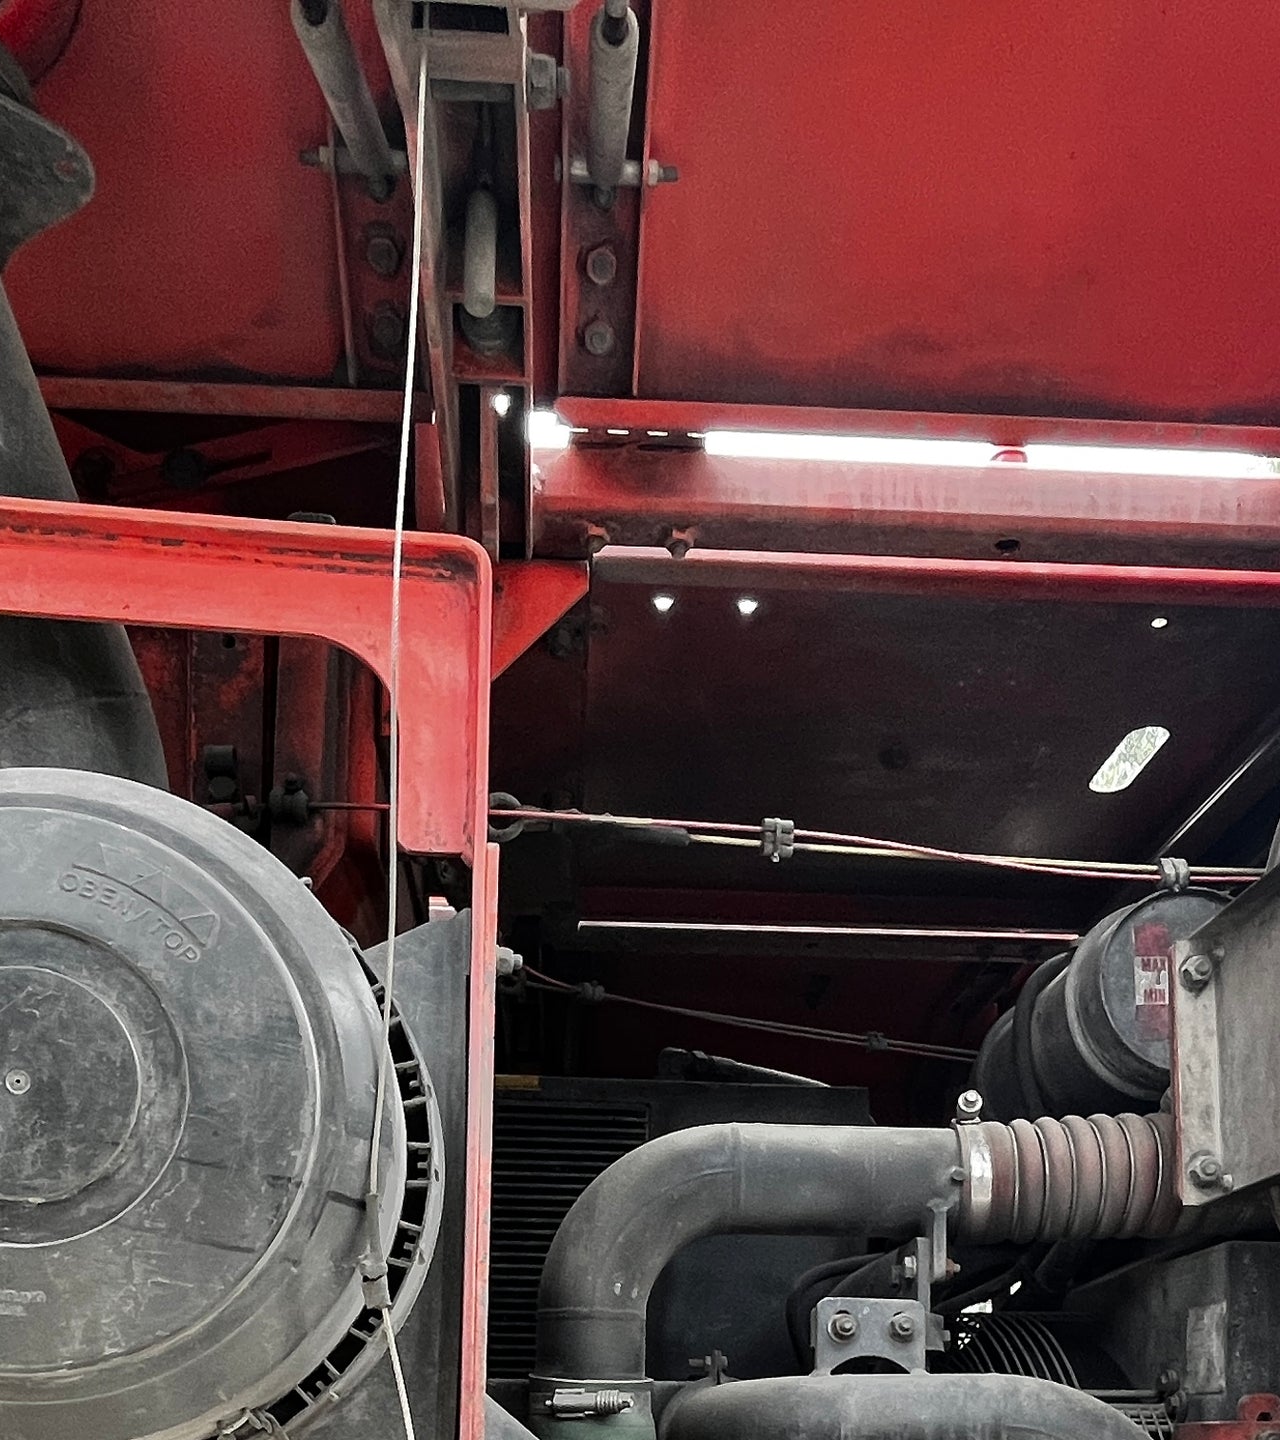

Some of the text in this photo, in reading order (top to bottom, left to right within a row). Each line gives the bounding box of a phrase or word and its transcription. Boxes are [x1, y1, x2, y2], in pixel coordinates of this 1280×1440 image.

[148, 916, 200, 962] TOP
[1141, 958, 1167, 972] MAX
[1143, 988, 1166, 1003] MIN
